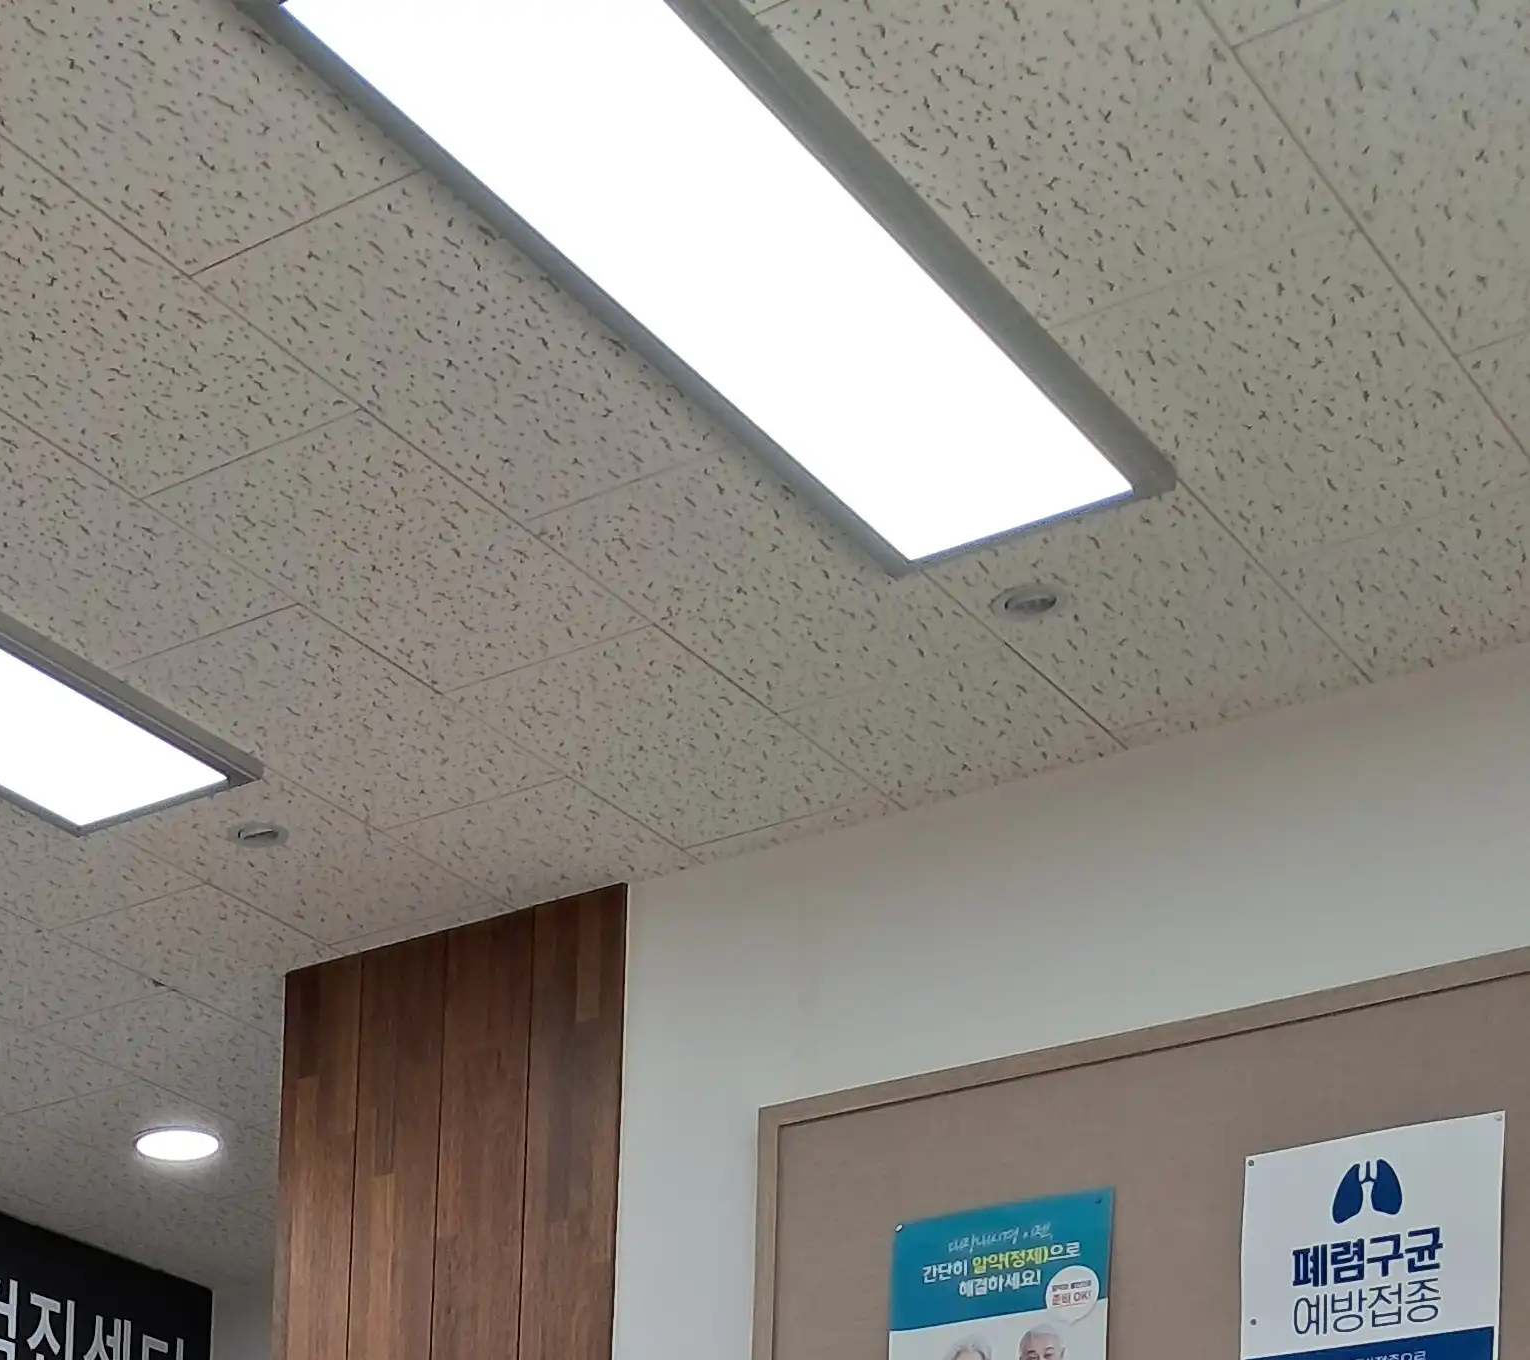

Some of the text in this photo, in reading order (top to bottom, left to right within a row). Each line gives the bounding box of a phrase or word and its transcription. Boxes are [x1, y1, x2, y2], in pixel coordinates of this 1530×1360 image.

[922, 1241, 1081, 1284] 간단히 알약(정제)으로
[1291, 1226, 1444, 1288] 폐렴구균
[958, 1269, 1041, 1297] 해결하세요!
[1293, 1277, 1442, 1336] 예방접종
